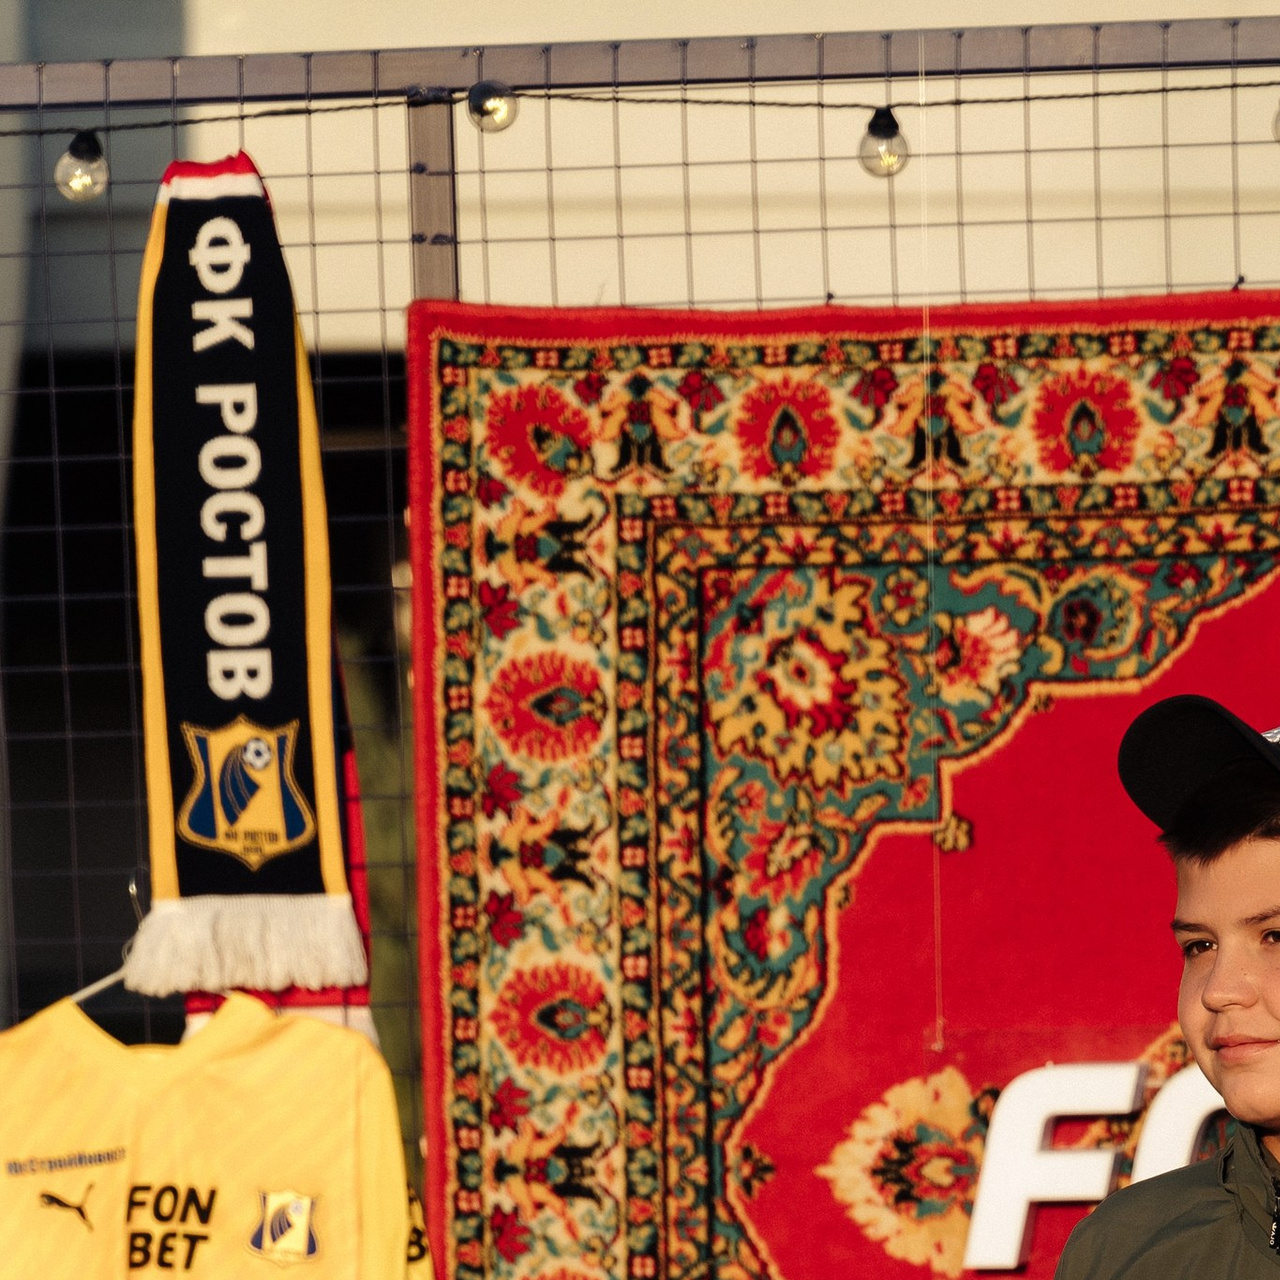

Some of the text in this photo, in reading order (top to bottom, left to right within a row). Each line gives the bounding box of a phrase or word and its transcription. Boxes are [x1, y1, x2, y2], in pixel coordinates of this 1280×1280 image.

[188, 215, 273, 700] ФК РОСТОВ
[127, 1185, 216, 1224] FON
[129, 1232, 209, 1270] BET
